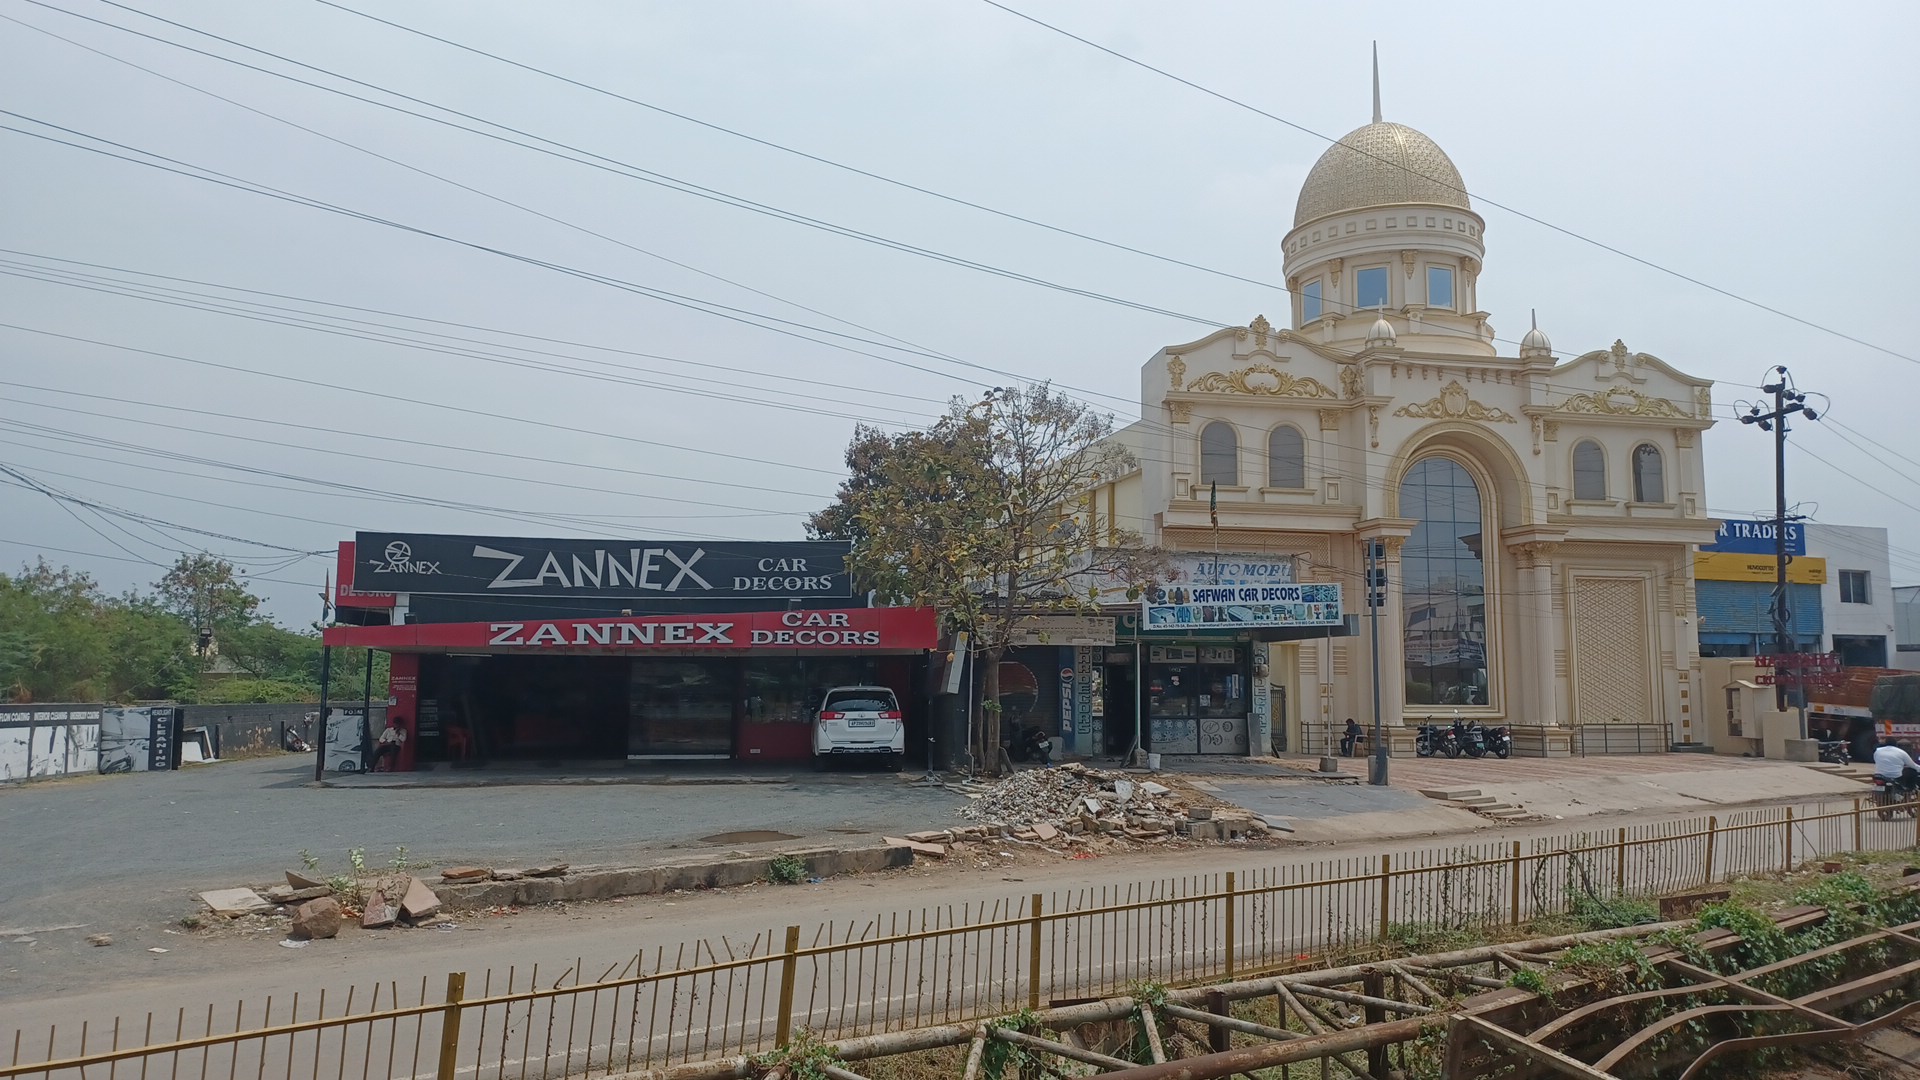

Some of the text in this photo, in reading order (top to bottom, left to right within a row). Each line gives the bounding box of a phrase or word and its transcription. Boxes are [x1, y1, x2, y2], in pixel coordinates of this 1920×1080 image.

[369, 559, 442, 575] ZANNEX
[472, 544, 714, 592] ZANNEX
[757, 557, 809, 572] CAR
[732, 576, 832, 591] DECORS
[1192, 587, 1300, 603] SAFWAN CAR DECORS
[781, 612, 851, 627] CAR
[489, 623, 734, 646] ZANNEX
[750, 630, 880, 645] DECORS
[1062, 682, 1072, 732] PEPSI
[11, 712, 31, 722] COATING
[33, 711, 68, 721] INTERIOR CLEANING
[155, 716, 168, 768] CLEANING
